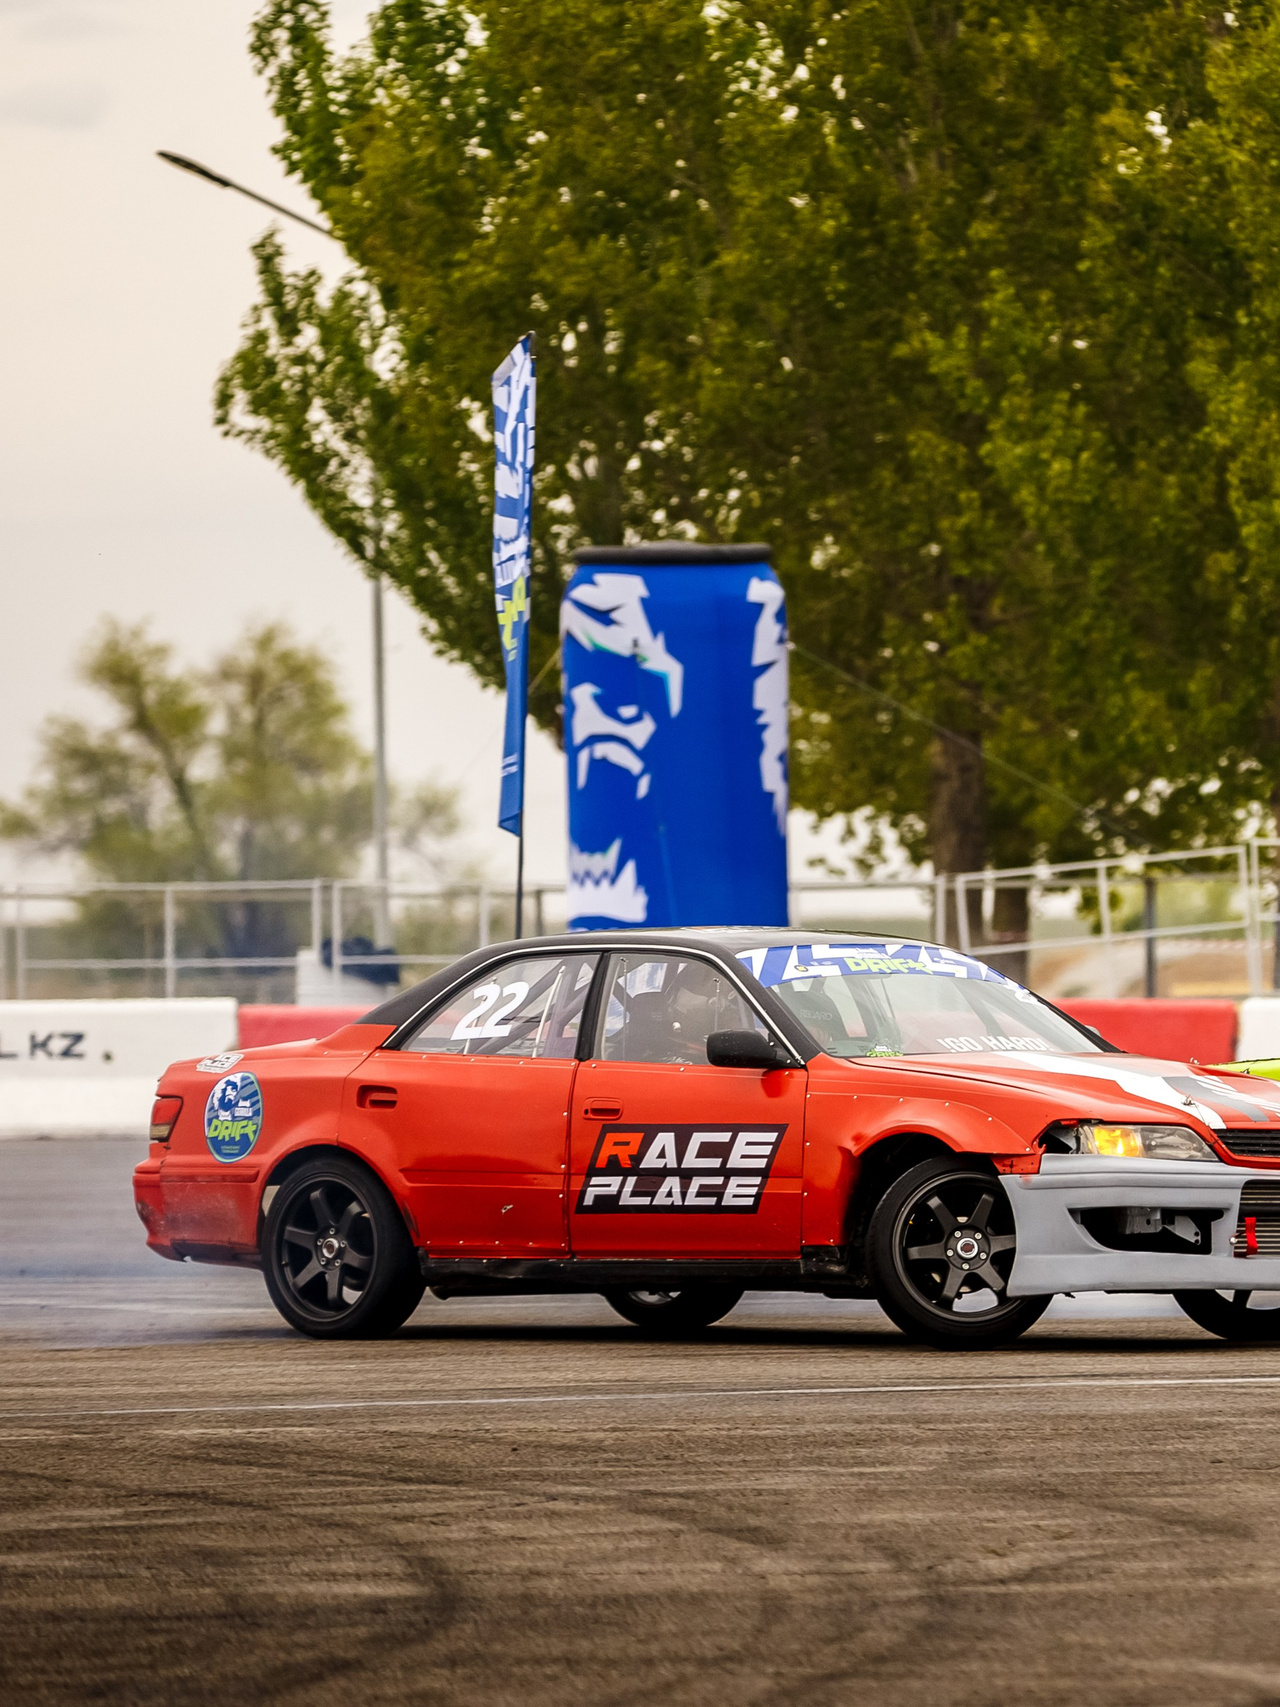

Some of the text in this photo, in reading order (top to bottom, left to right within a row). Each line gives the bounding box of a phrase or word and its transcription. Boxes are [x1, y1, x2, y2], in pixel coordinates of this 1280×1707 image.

[842, 957, 934, 975] DRIFT
[450, 981, 530, 1041] 22
[207, 1119, 257, 1143] DRIFT
[595, 1132, 779, 1168] RACE
[583, 1176, 762, 1206] PLACE
